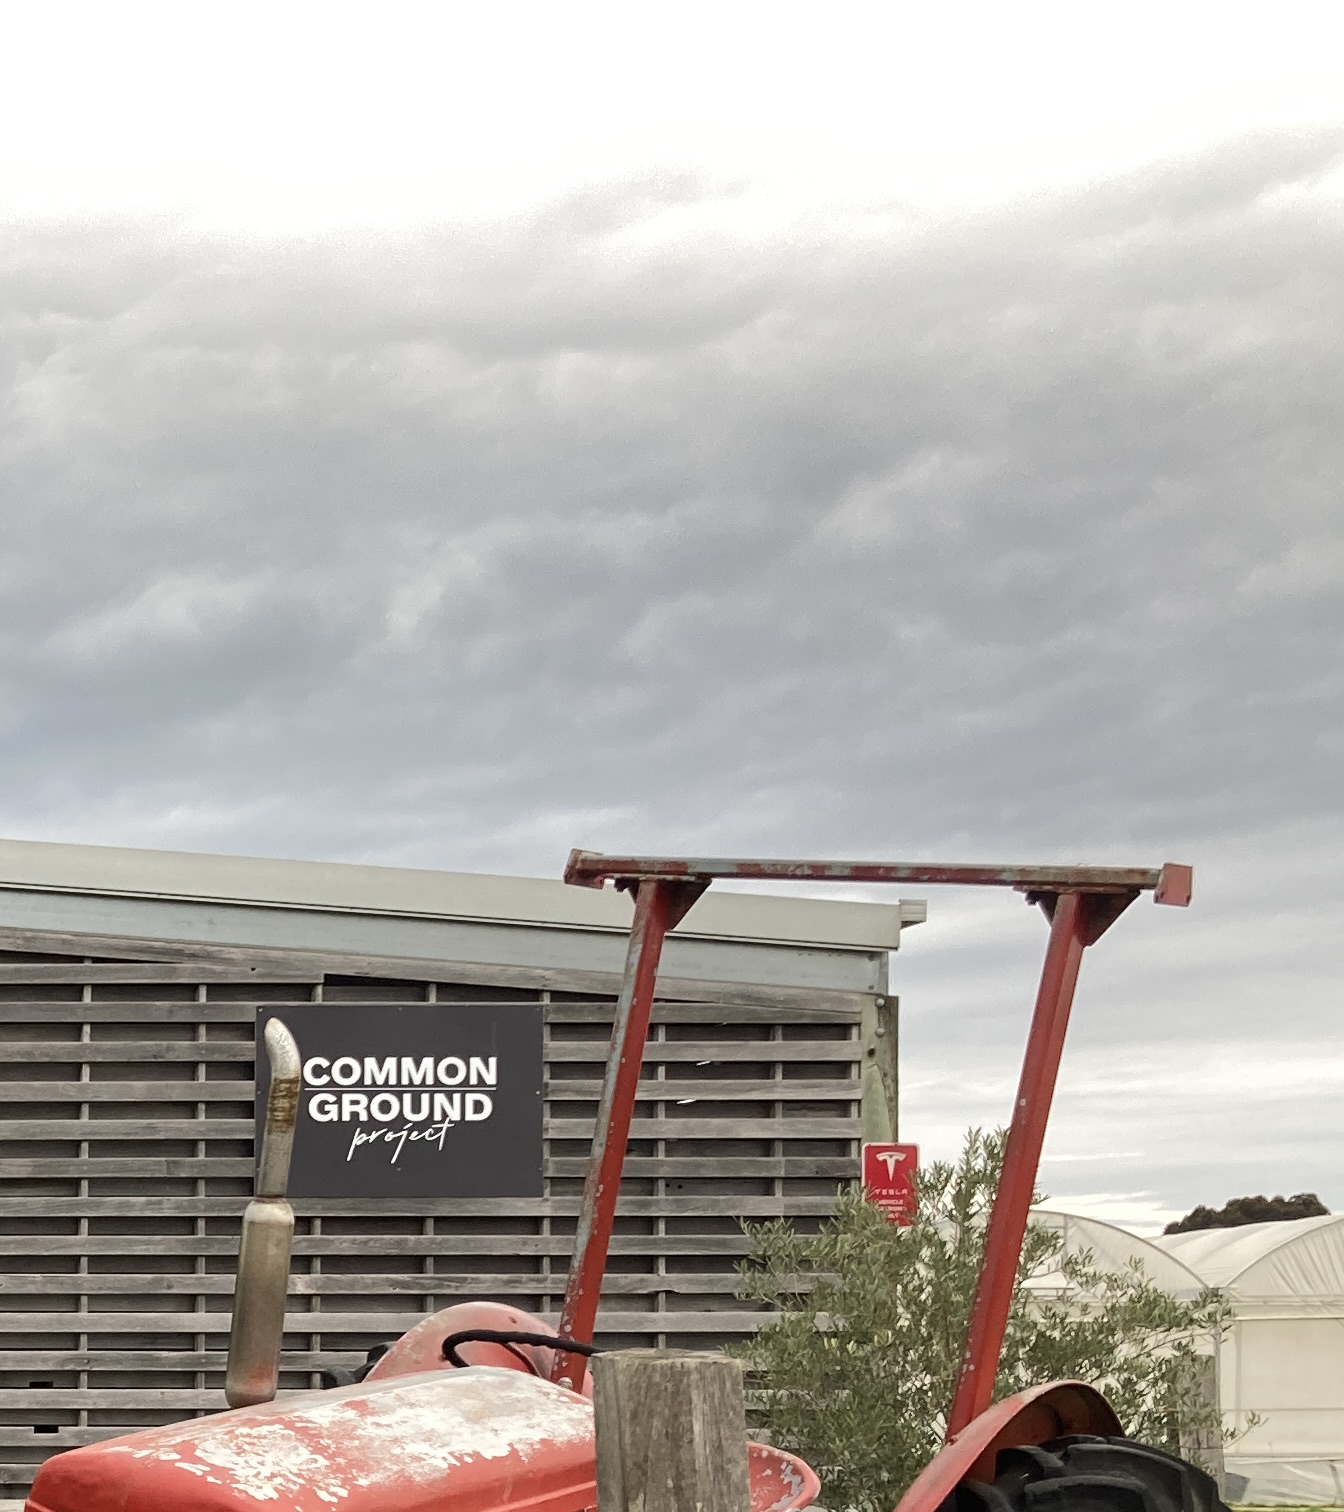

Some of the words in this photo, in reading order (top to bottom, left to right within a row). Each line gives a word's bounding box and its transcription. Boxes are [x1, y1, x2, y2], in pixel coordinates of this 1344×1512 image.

[302, 1056, 498, 1086] COMMON
[308, 1092, 494, 1122] GROUND
[346, 1117, 455, 1164] project
[875, 1188, 908, 1196] TESLA
